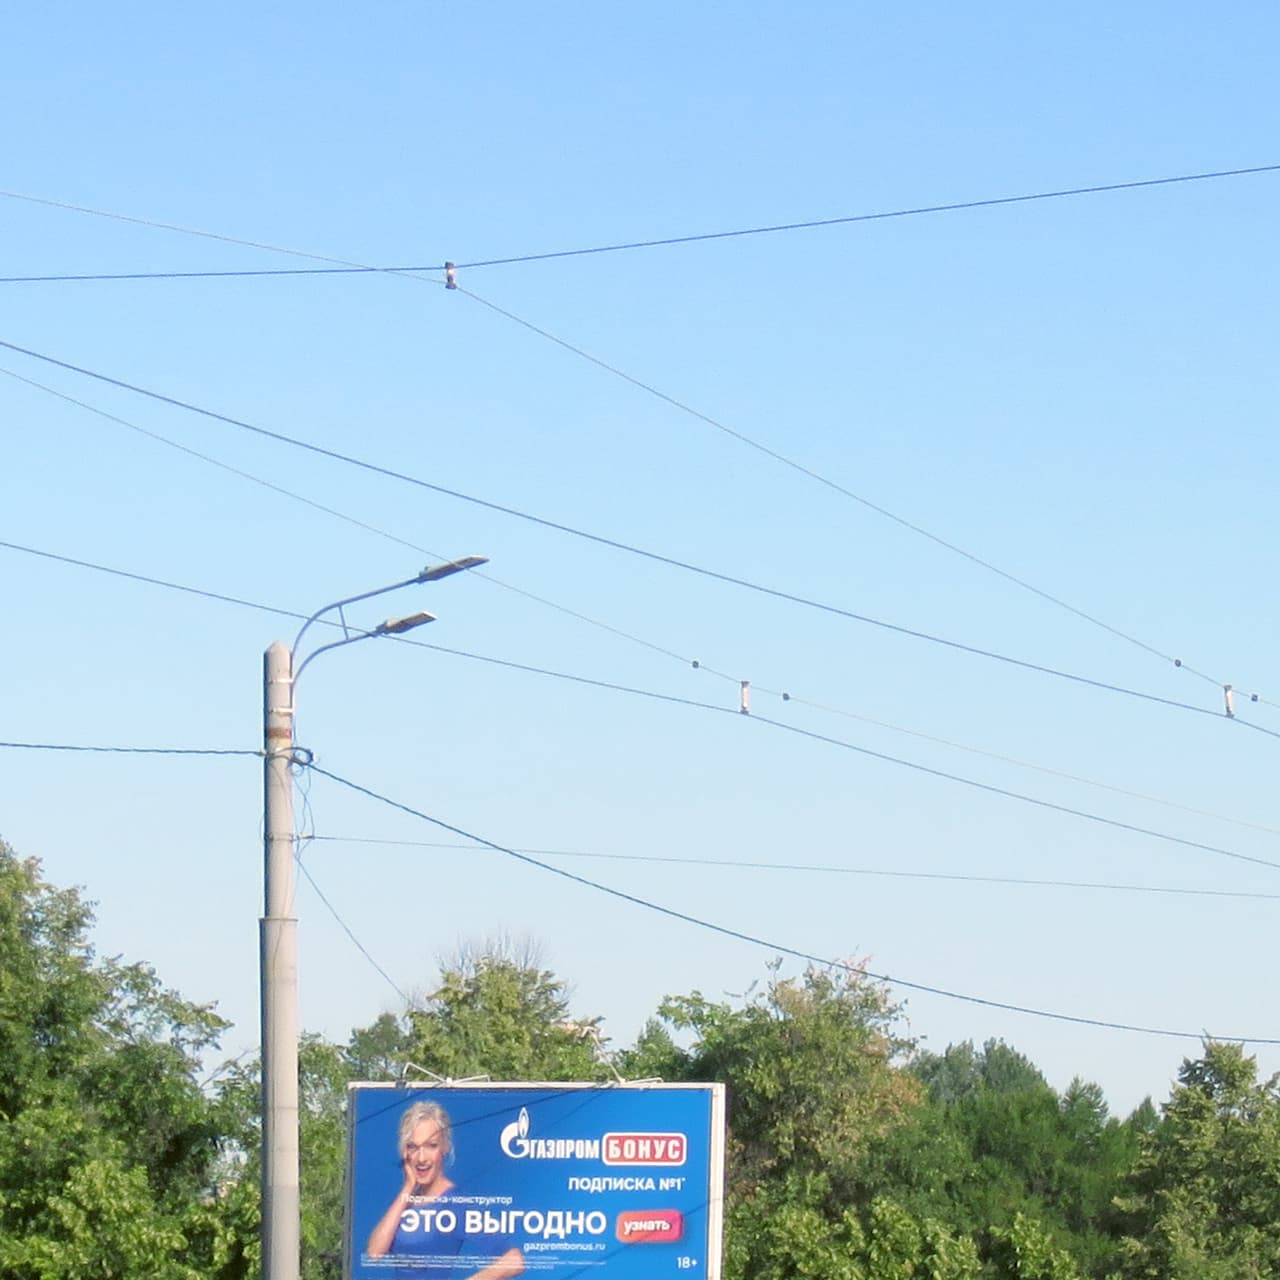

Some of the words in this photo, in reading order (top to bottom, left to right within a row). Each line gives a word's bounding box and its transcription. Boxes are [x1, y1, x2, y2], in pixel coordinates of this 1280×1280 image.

[529, 1139, 600, 1159] ГАЗПРОМ
[608, 1139, 681, 1160] БОНУС
[568, 1177, 656, 1193] ПОДПИСКА
[400, 1209, 457, 1233] ЭТО
[465, 1210, 607, 1239] ВЫГОДНО
[623, 1219, 671, 1235] узнать
[523, 1241, 606, 1252] gazprombonus.ru
[677, 1256, 698, 1269] 18+
